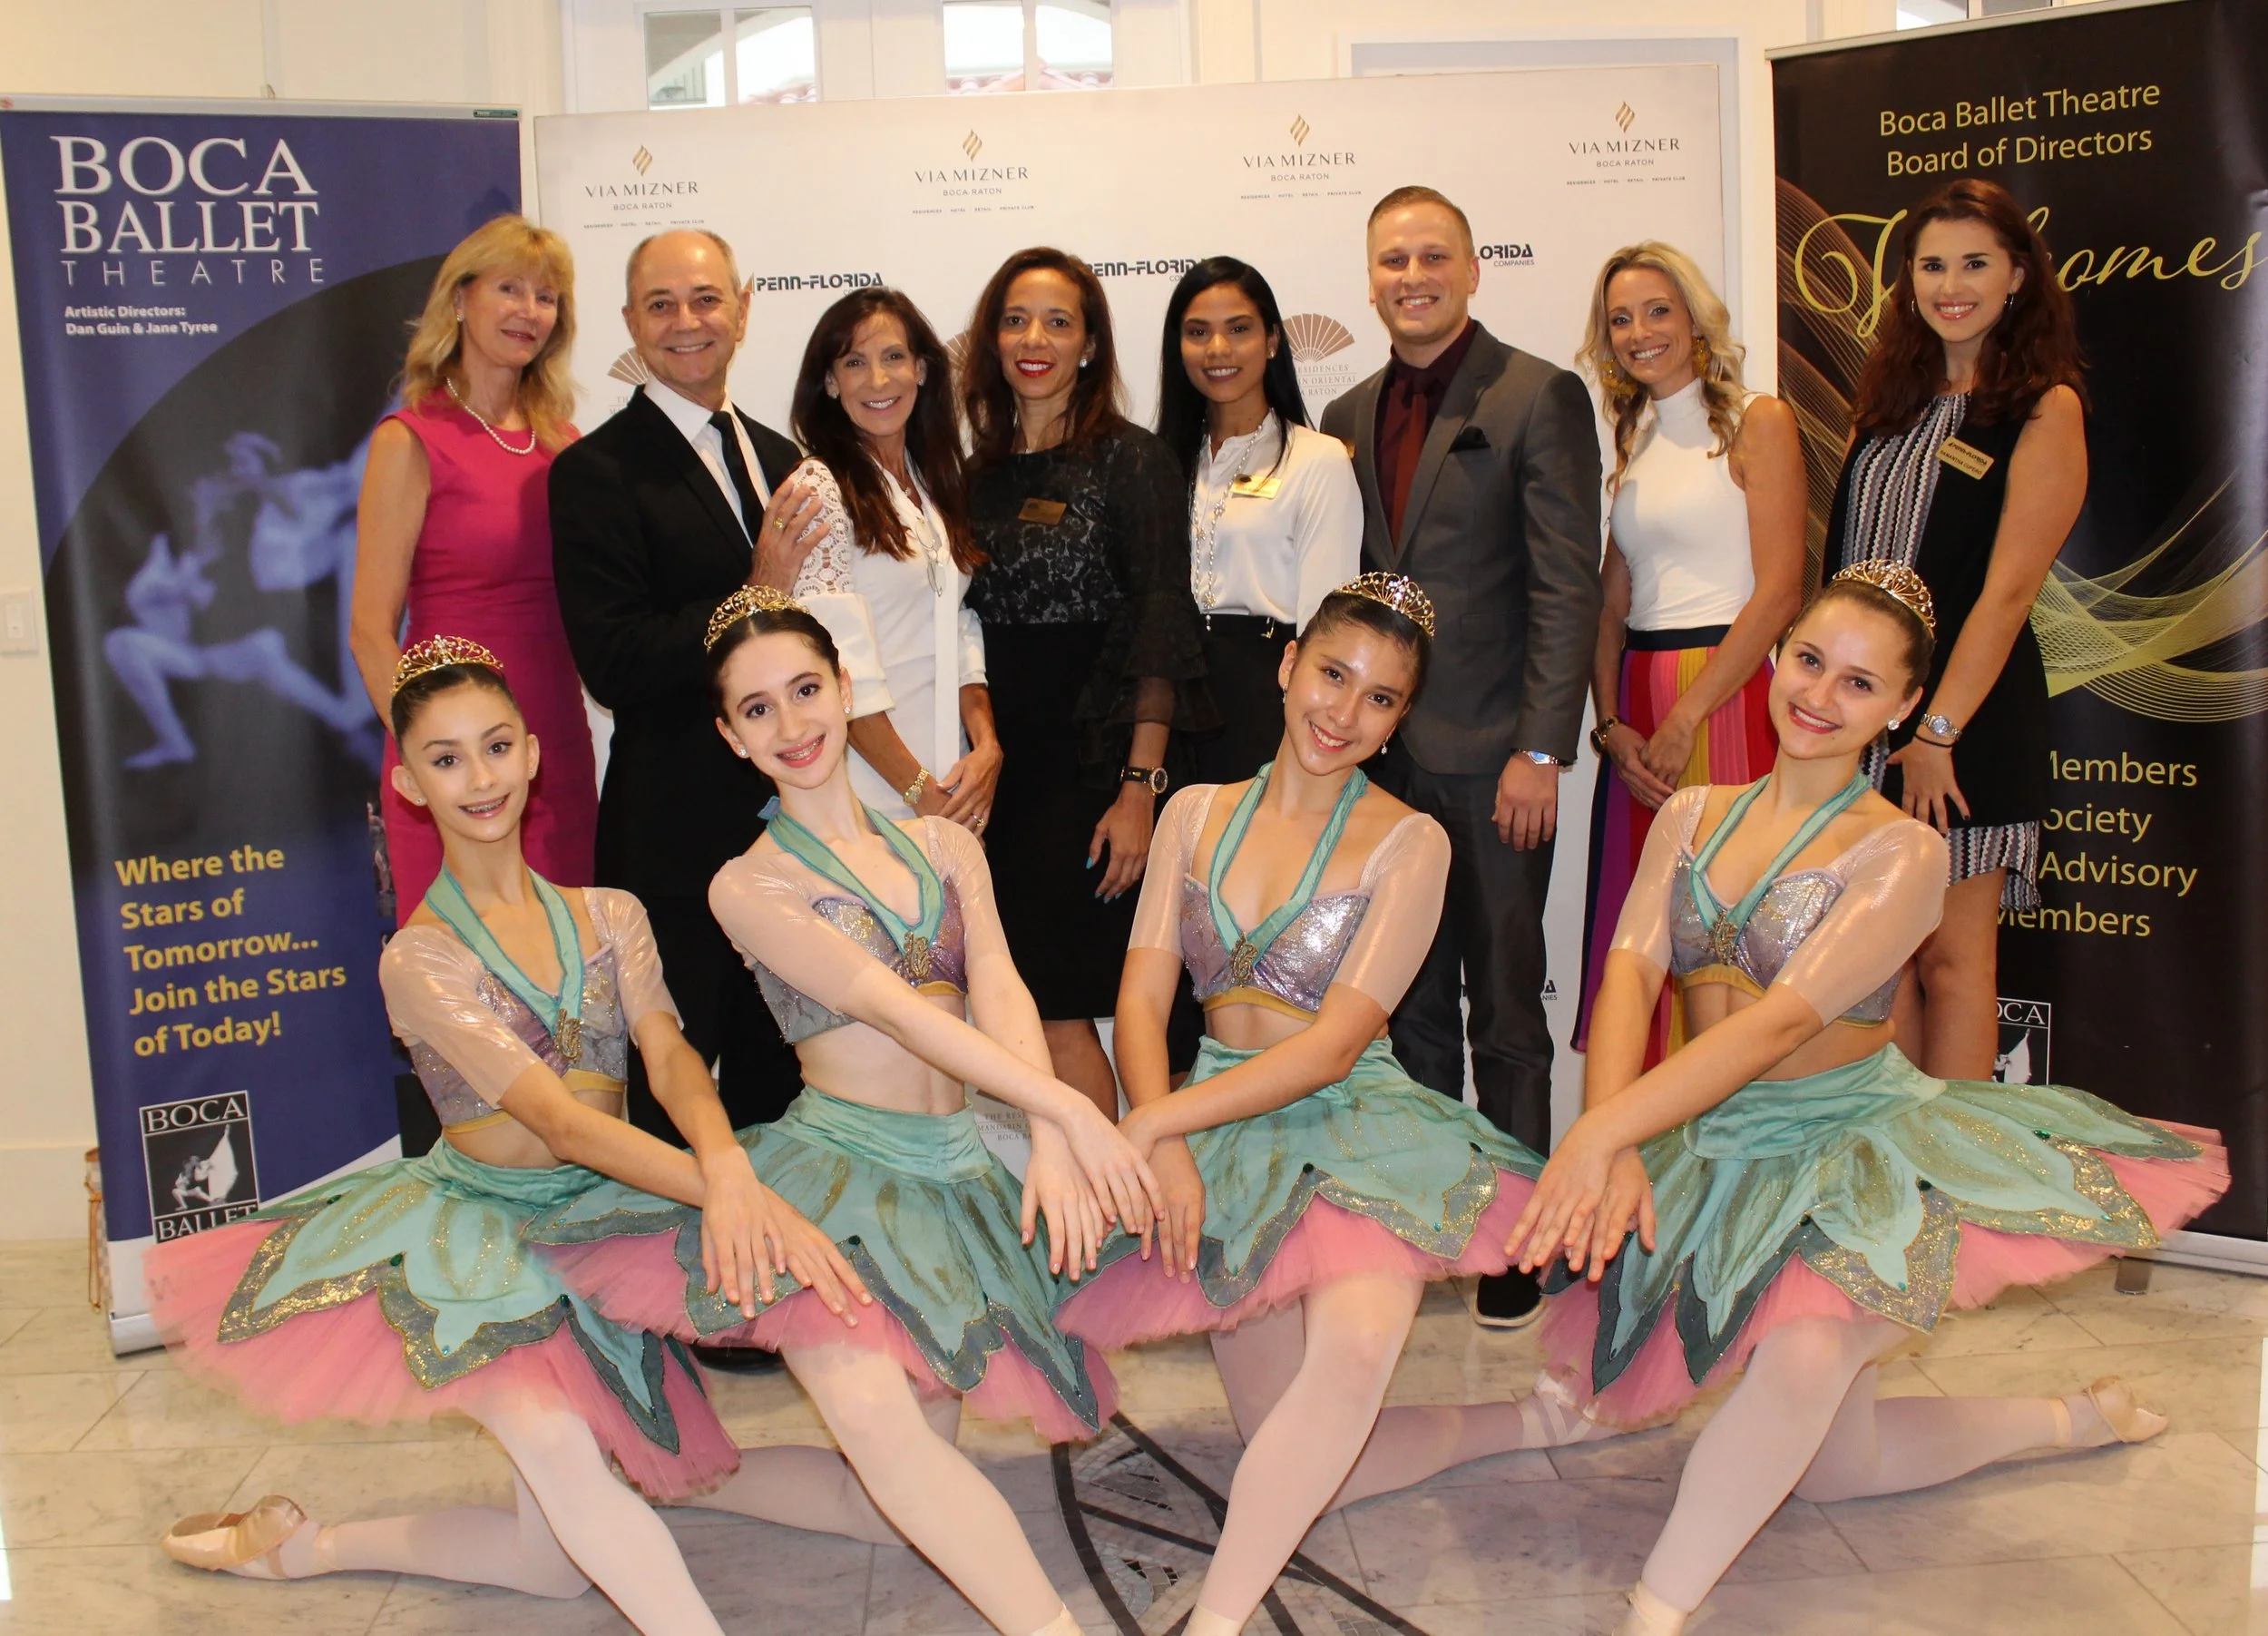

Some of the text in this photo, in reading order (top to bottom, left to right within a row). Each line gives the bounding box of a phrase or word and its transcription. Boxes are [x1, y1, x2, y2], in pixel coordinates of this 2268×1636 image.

[1879, 83, 2161, 137] Boca Ballet Theatre
[1568, 138, 1679, 154] VIA MIZNER
[1887, 128, 2153, 177] Board of Directors
[49, 135, 319, 197] BOCA
[1243, 152, 1355, 168] VIA MIZNER
[1596, 158, 1654, 168] BOCA RATON
[914, 167, 1029, 182] VIA MIZNER
[585, 181, 699, 198] VIA MIZNER
[943, 189, 968, 197] BOCA
[612, 201, 672, 211] BOCA RATON
[54, 200, 319, 254] BALLET
[61, 259, 325, 287] THEATRE
[1493, 260, 1535, 268] COMPANIES
[756, 272, 884, 291] PENN-FLORIDA
[64, 305, 186, 318] Artistic Directors:
[65, 321, 218, 337] Dan Guin & Jane Tyree
[1311, 375, 1356, 385] ORIENTAL
[1309, 387, 1337, 397] RATON
[2042, 803, 2153, 843] ociety
[115, 845, 285, 887] Where the
[2038, 851, 2198, 896] Advisory
[121, 887, 246, 929] Stars of
[122, 929, 319, 972] Tomorrow...
[128, 964, 347, 1015] Join the Stars
[133, 1011, 283, 1057] of Today!
[145, 1096, 245, 1133] BOCA
[997, 1132, 1019, 1141] BOCA
